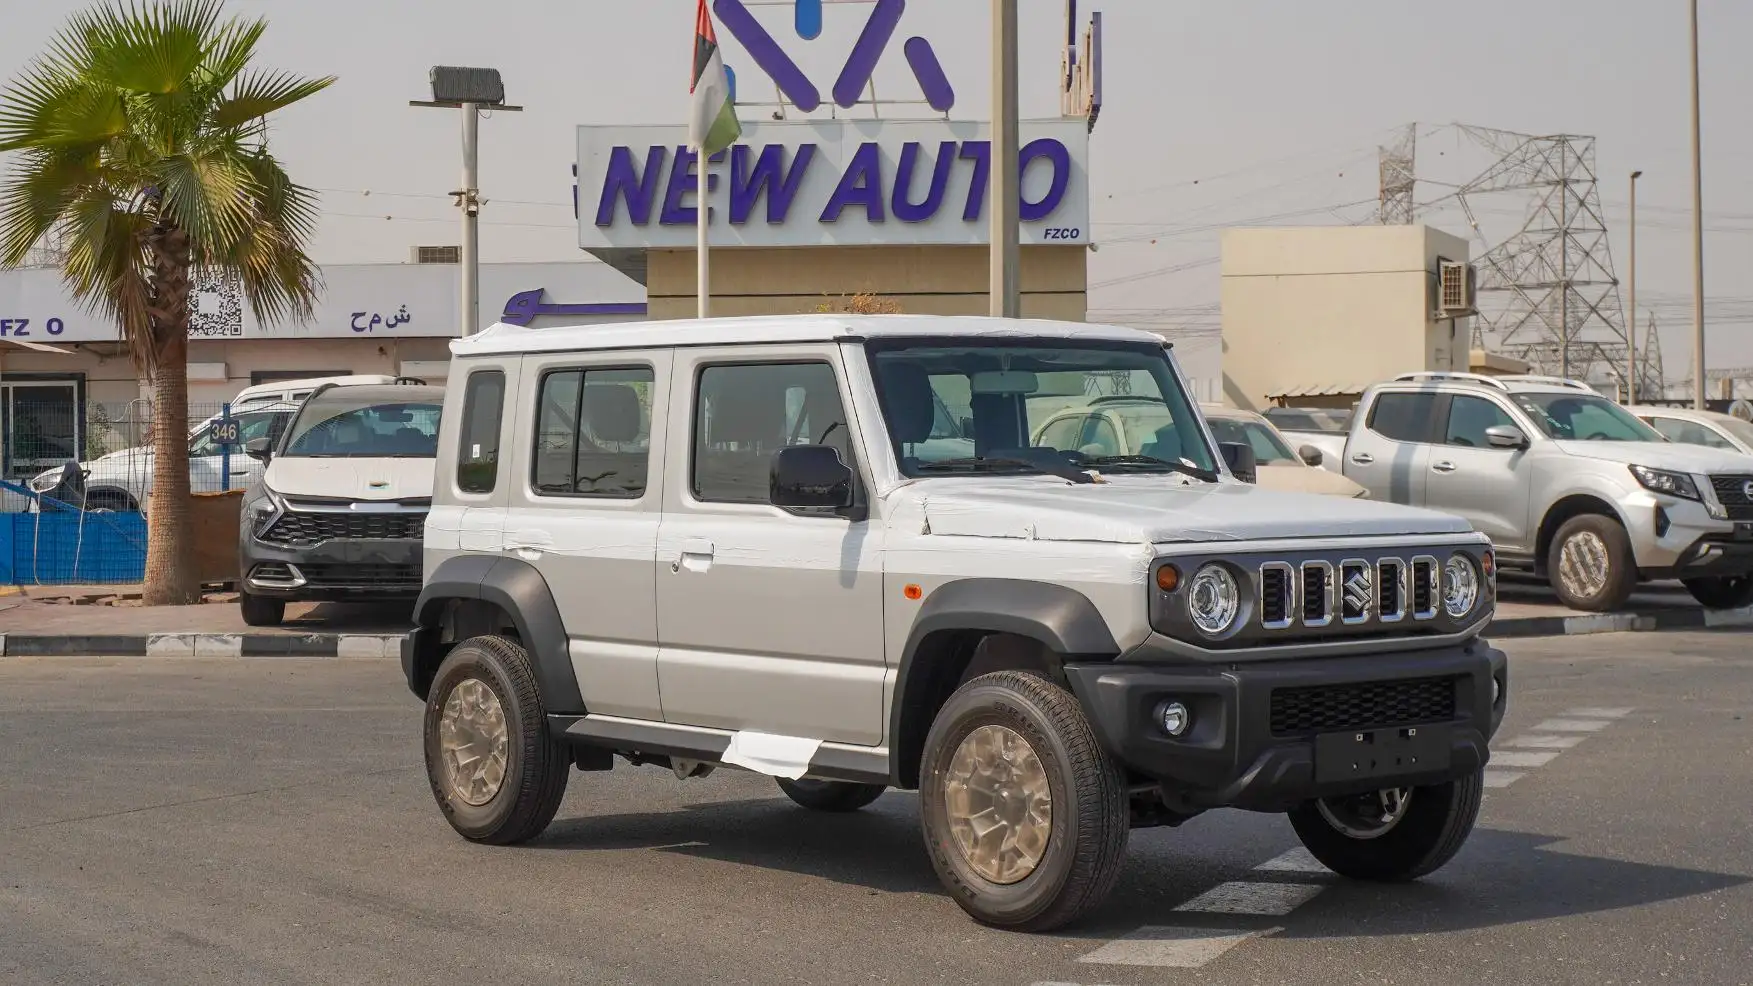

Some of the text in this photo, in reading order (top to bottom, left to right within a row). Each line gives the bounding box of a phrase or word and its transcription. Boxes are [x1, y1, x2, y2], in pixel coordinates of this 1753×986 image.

[595, 138, 1071, 226] NEW AUTO
[1043, 227, 1080, 240] FZCO
[211, 423, 237, 440] 346
